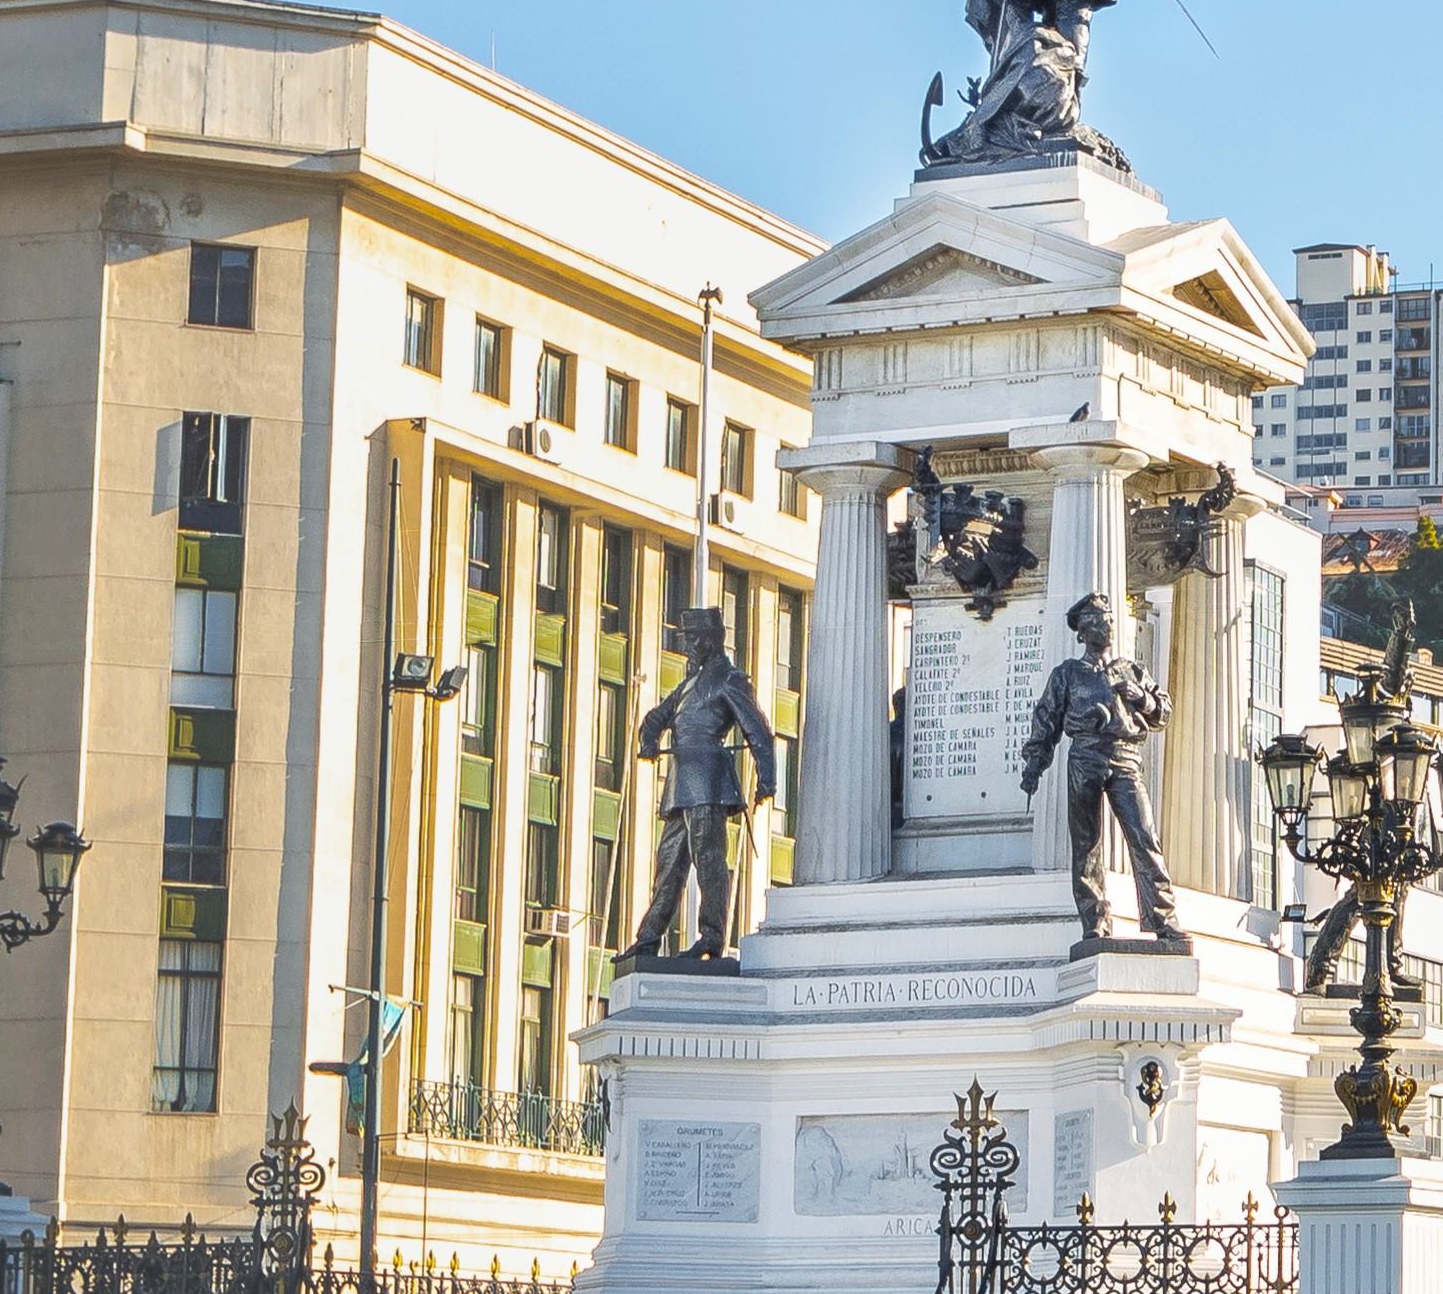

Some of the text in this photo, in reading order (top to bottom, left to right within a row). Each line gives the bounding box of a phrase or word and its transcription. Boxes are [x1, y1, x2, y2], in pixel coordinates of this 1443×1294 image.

[915, 630, 962, 644] DESPENSERO
[914, 642, 957, 656] SANGRADOR
[914, 656, 958, 668] CARPINTERO
[914, 668, 949, 681] CALAFATE
[950, 690, 1000, 702] CONDESTABLE
[950, 703, 1000, 714] CONDESTABLE
[914, 718, 944, 730] TIMONEL
[913, 730, 946, 743] MAESTRE
[794, 975, 1037, 1005] LA PATRIA RECONOCIDA
[884, 1218, 934, 1235] ARICA
